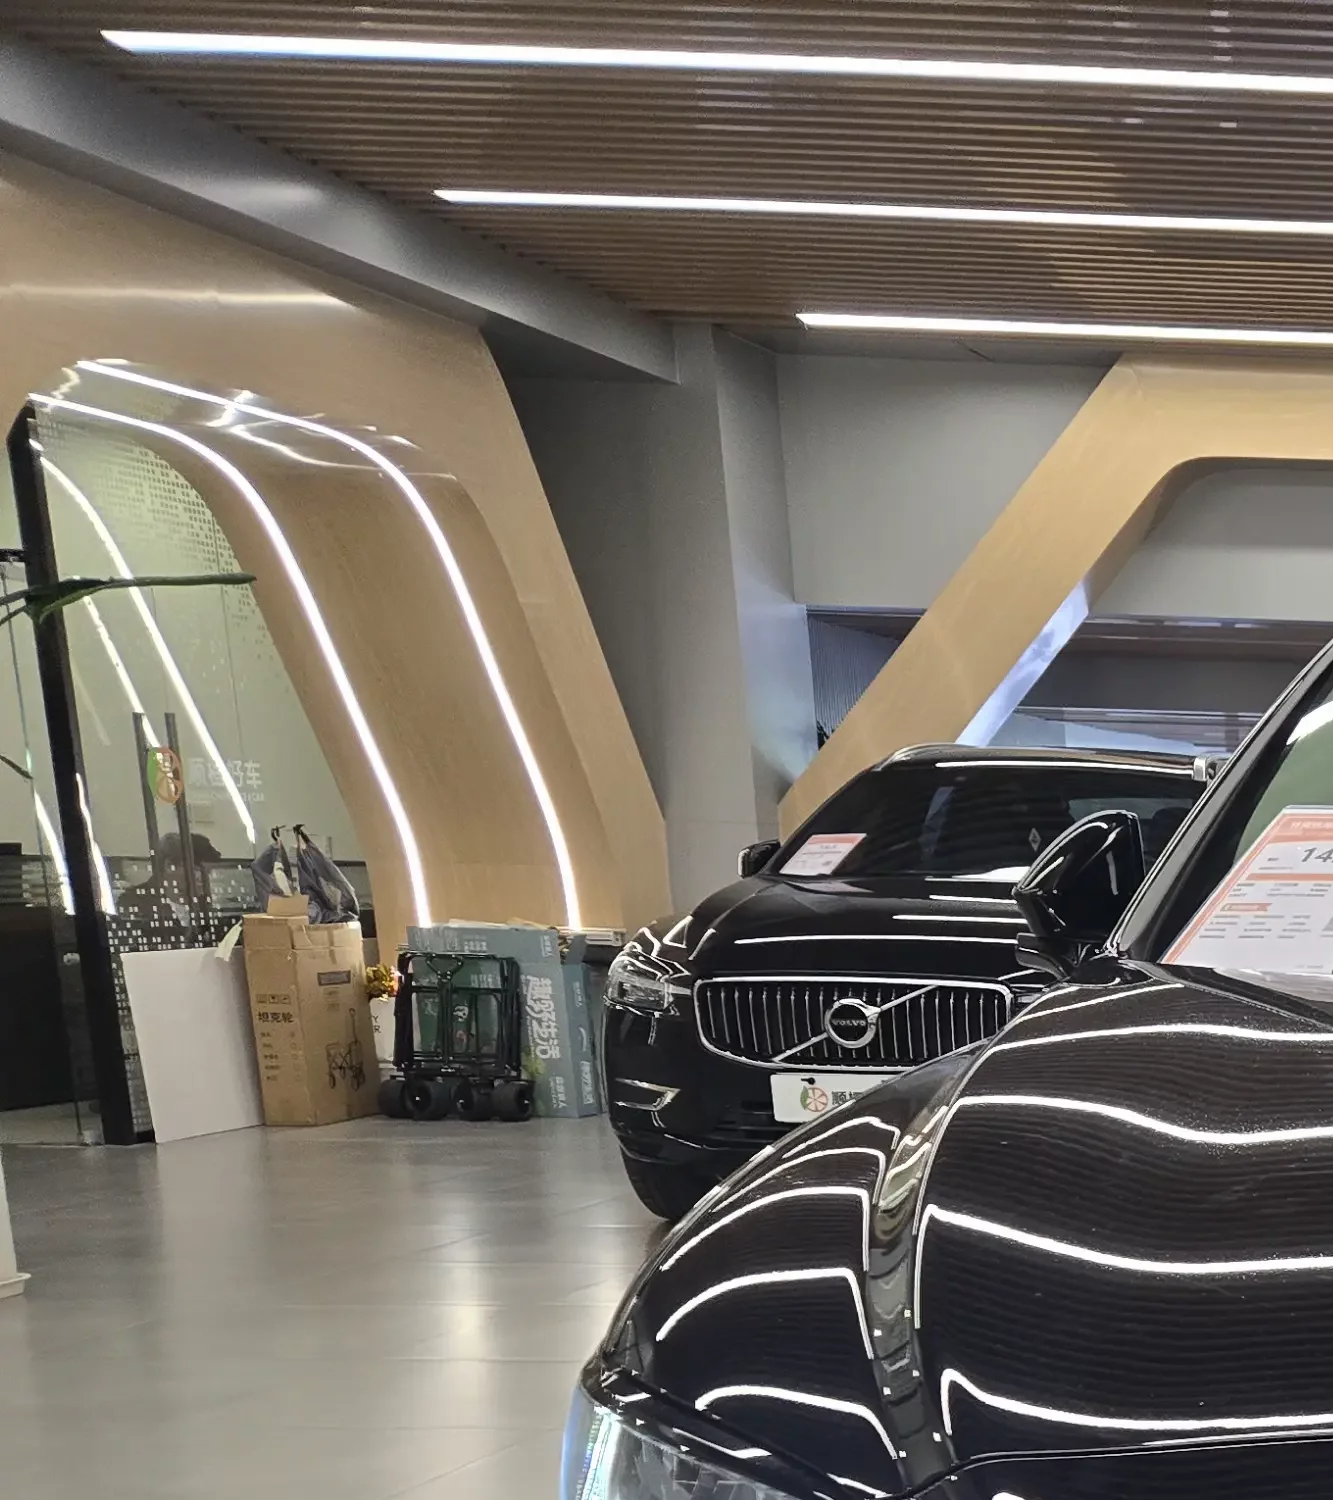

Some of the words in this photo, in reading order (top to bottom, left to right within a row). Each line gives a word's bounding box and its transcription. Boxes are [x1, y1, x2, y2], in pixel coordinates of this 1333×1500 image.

[258, 1011, 294, 1024] 坦克轮
[832, 1019, 866, 1027] VOLVO
